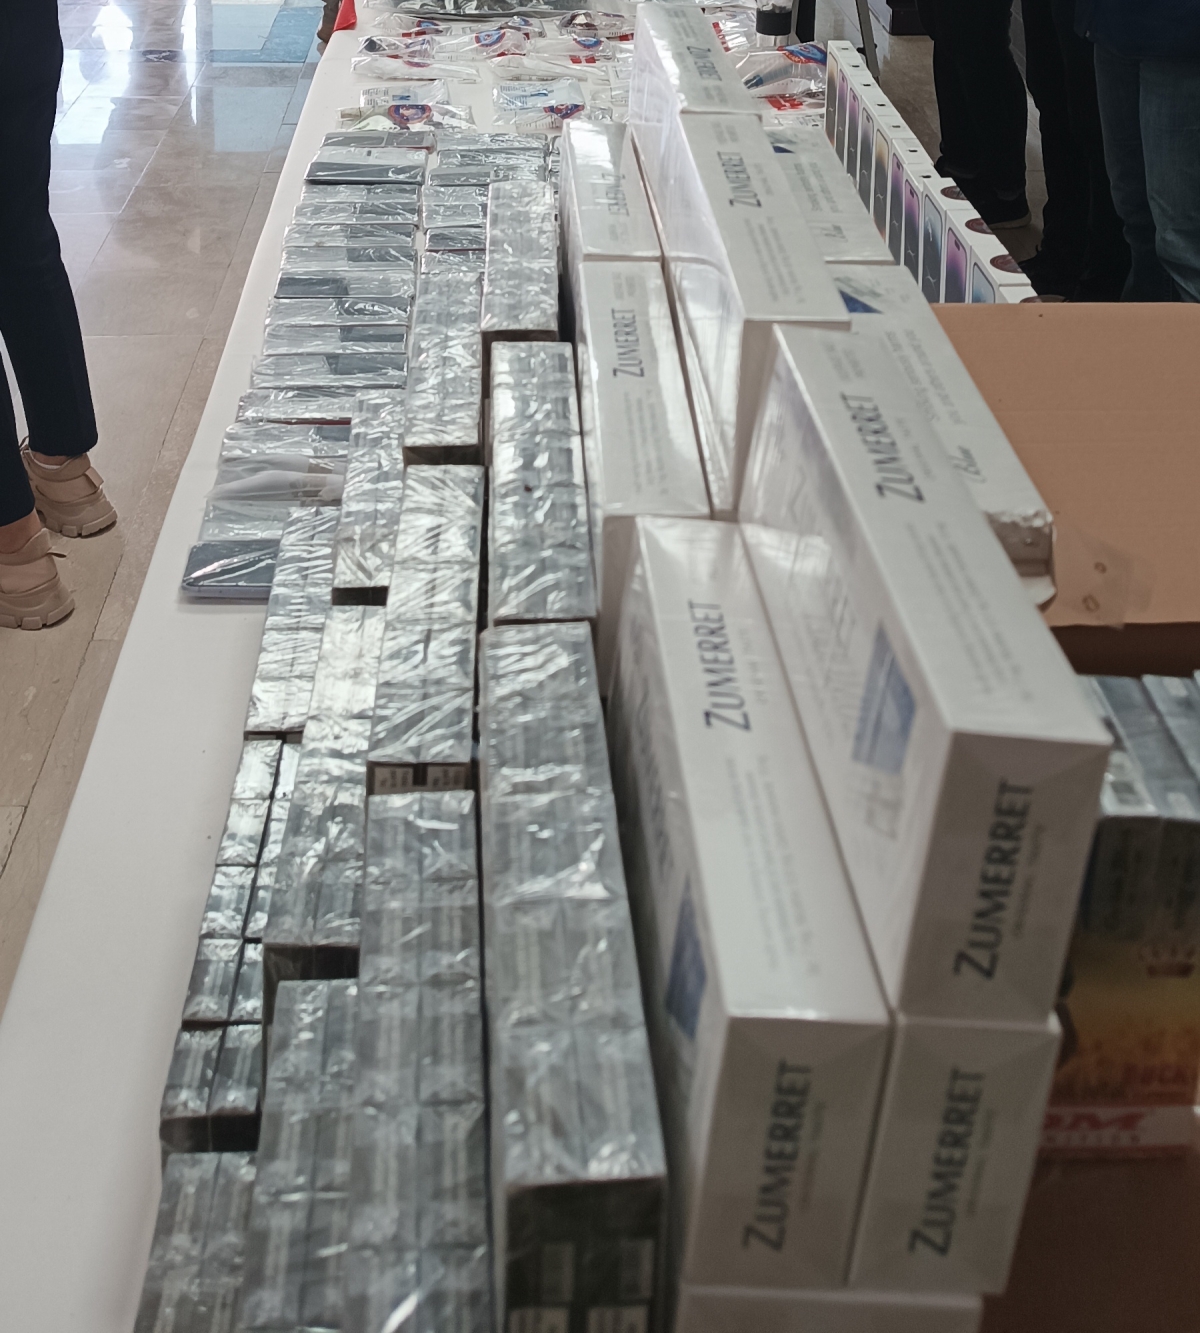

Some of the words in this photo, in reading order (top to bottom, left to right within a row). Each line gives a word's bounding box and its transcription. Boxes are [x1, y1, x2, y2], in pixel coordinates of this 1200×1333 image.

[717, 150, 762, 207] ZUMERRET
[611, 307, 645, 378] ZUMERRET
[840, 393, 926, 505] ZUMERRET
[688, 599, 752, 734] ZUMERRET
[952, 777, 1034, 982] ZUMERRET
[741, 1059, 814, 1253] ZUMERRET
[907, 1067, 987, 1258] ZUMERRET
